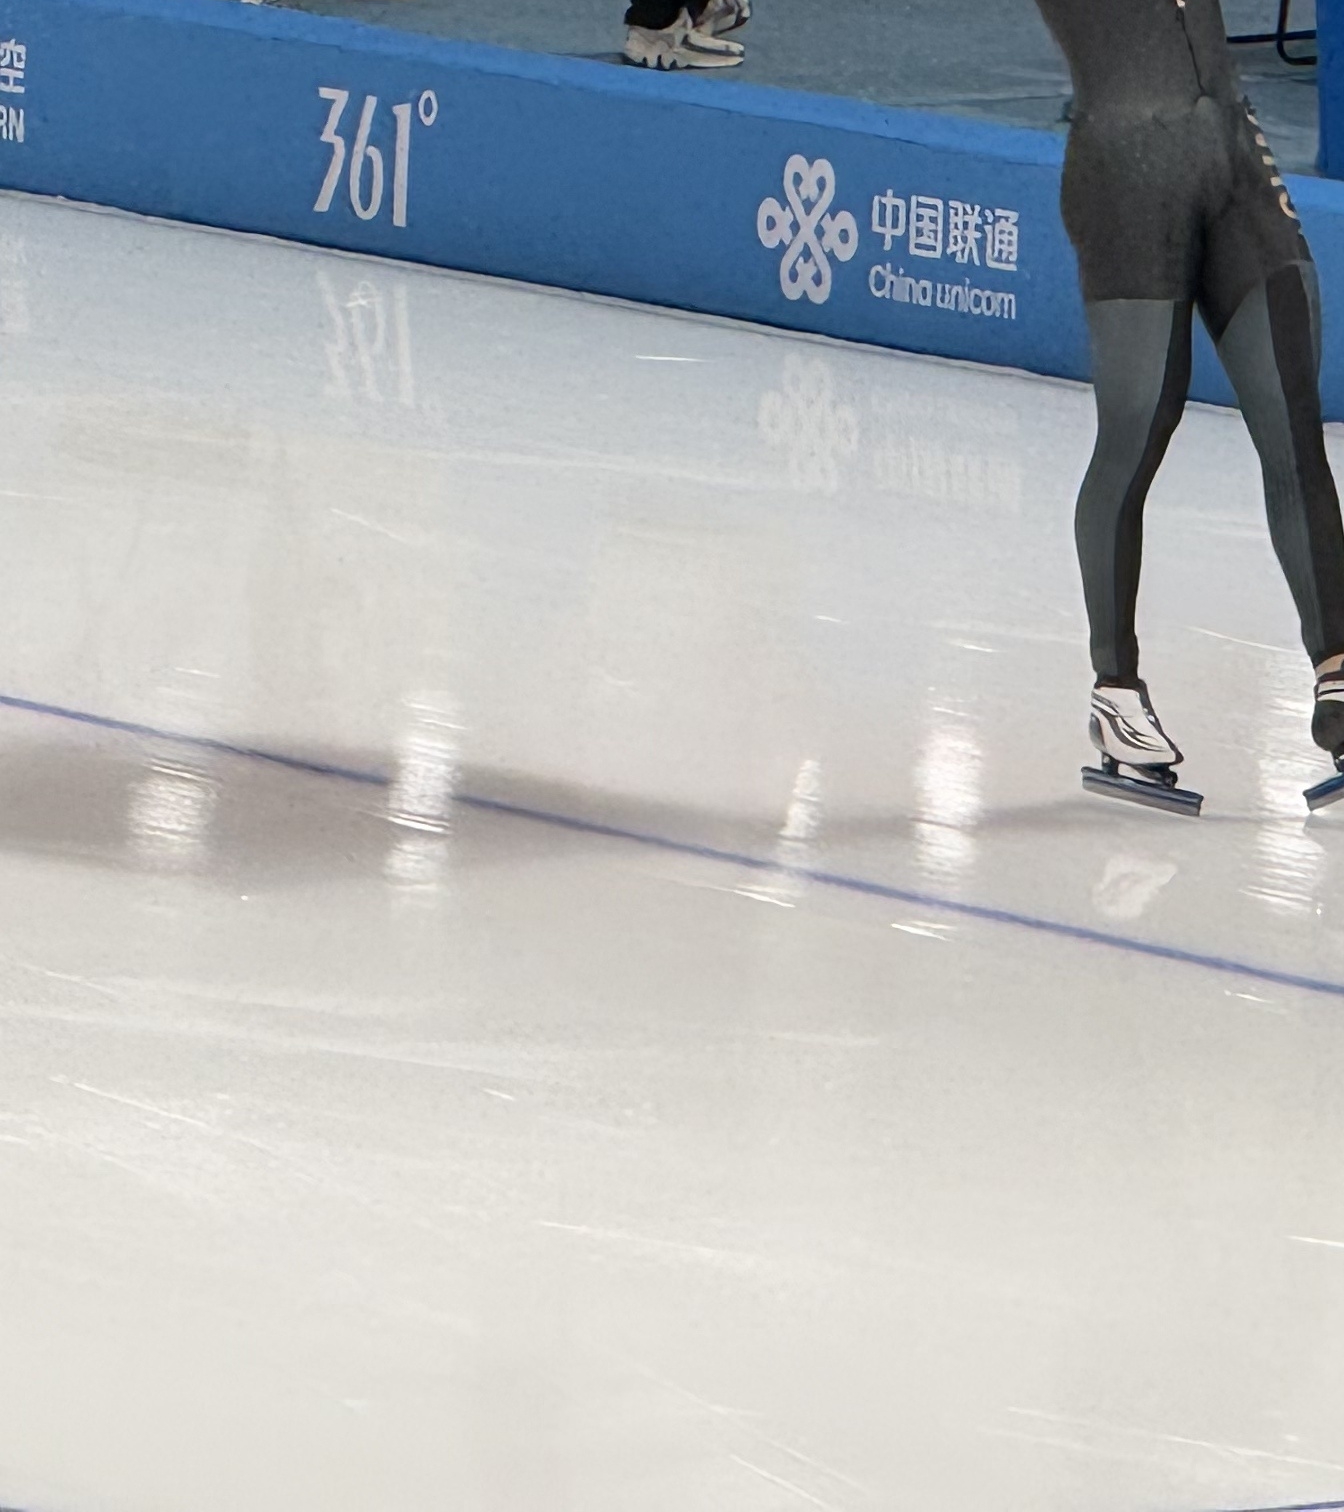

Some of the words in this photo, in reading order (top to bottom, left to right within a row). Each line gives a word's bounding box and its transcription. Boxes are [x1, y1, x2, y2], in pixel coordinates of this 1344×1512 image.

[871, 188, 1019, 272] 中国联通
[868, 262, 932, 307] China
[936, 277, 1016, 320] unicom
